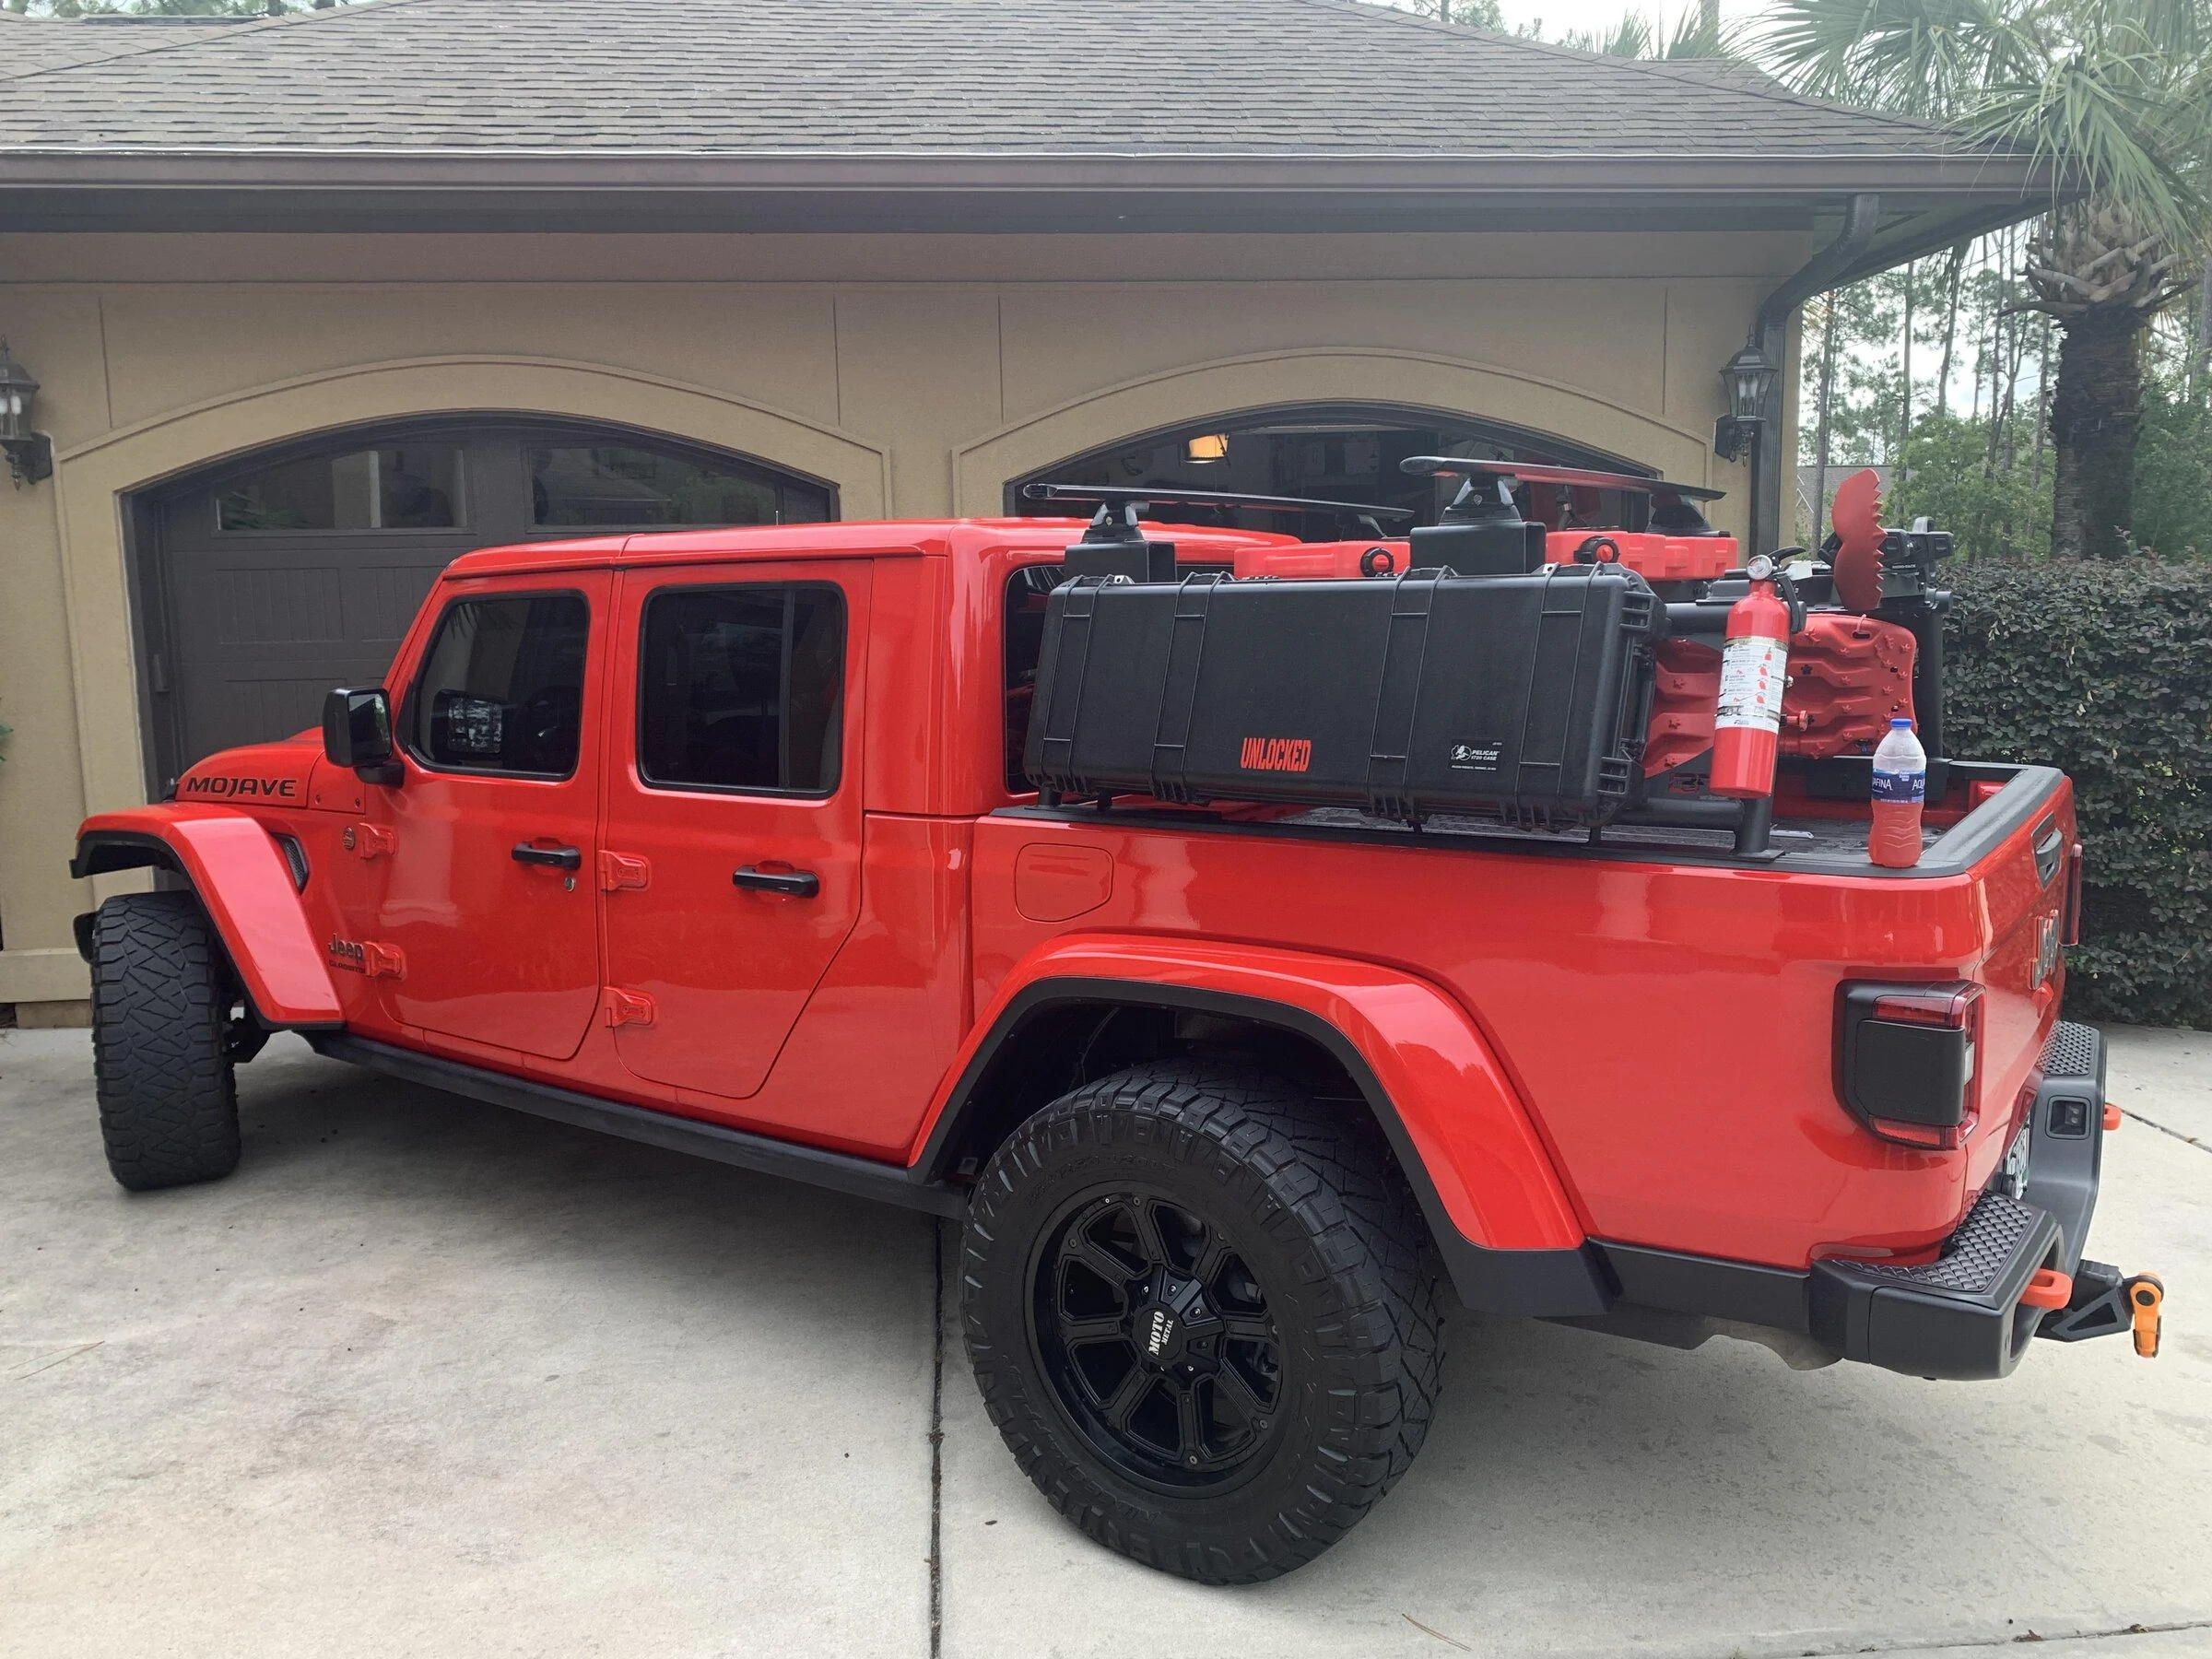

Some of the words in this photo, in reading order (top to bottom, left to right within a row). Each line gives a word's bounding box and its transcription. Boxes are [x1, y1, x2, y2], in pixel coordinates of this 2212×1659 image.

[1240, 736, 1312, 772] UNLOCKED
[186, 777, 296, 797] MOJAVE
[328, 932, 364, 964] Jeep
[1148, 1311, 1165, 1356] MOTO
[1161, 1319, 1174, 1346] METAL
